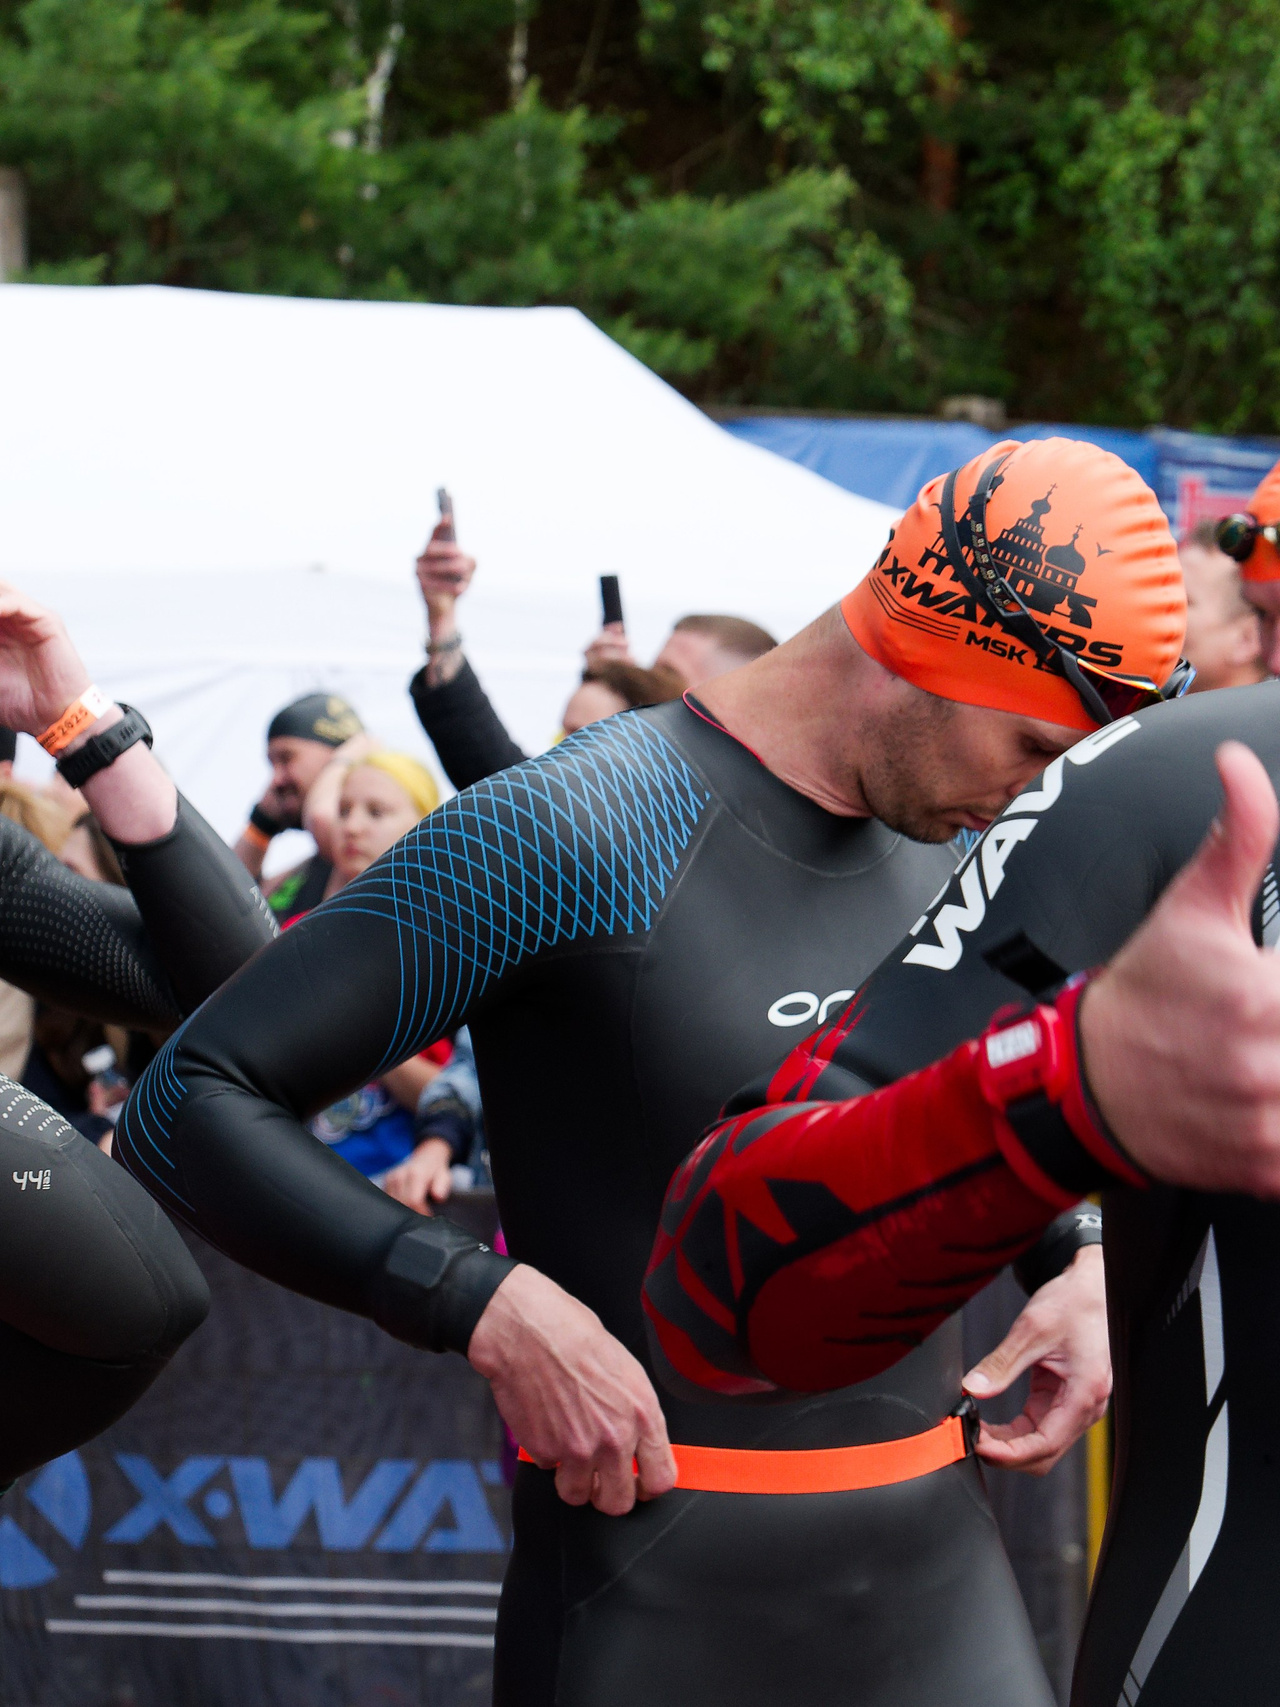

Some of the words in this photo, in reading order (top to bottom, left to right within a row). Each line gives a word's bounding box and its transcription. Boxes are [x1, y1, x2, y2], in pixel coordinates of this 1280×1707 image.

[965, 630, 1028, 666] MSK
[902, 715, 1142, 971] WAVE
[12, 1170, 43, 1191] 44
